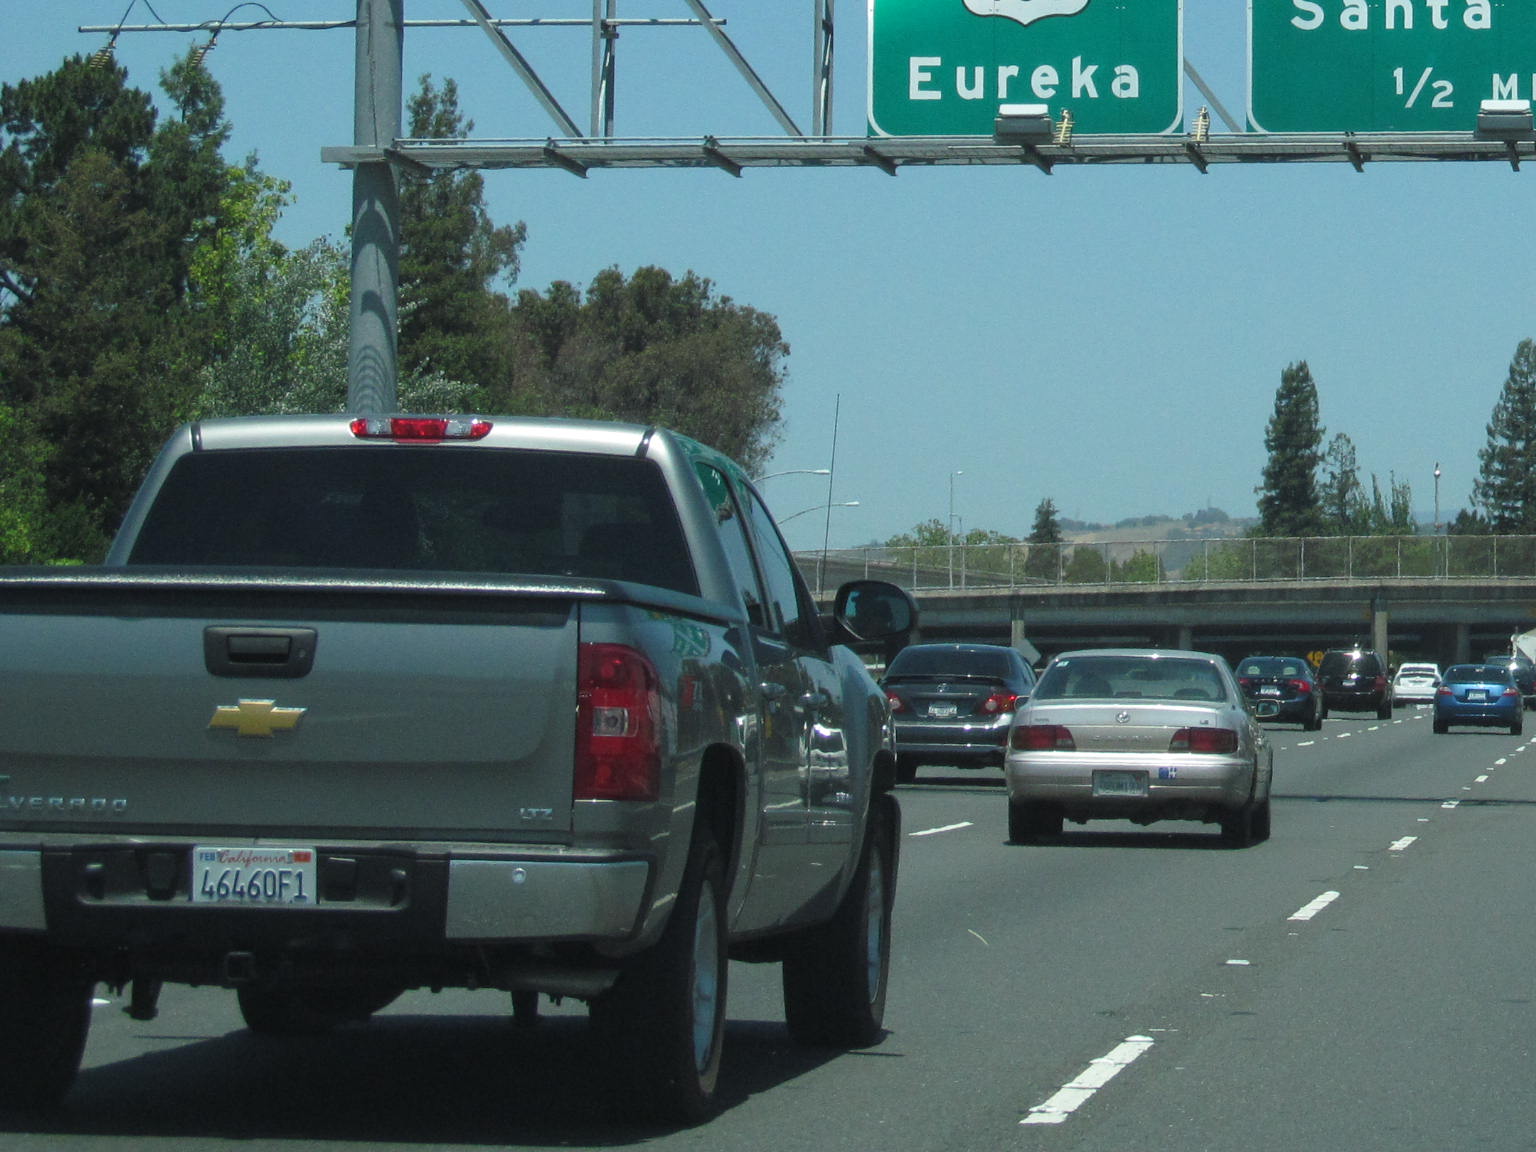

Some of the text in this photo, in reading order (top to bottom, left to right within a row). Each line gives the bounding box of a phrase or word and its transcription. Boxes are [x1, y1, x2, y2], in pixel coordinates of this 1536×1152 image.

[908, 55, 1140, 100] Eureka
[1393, 67, 1454, 109] 1/2
[202, 869, 308, 900] 46460F1
